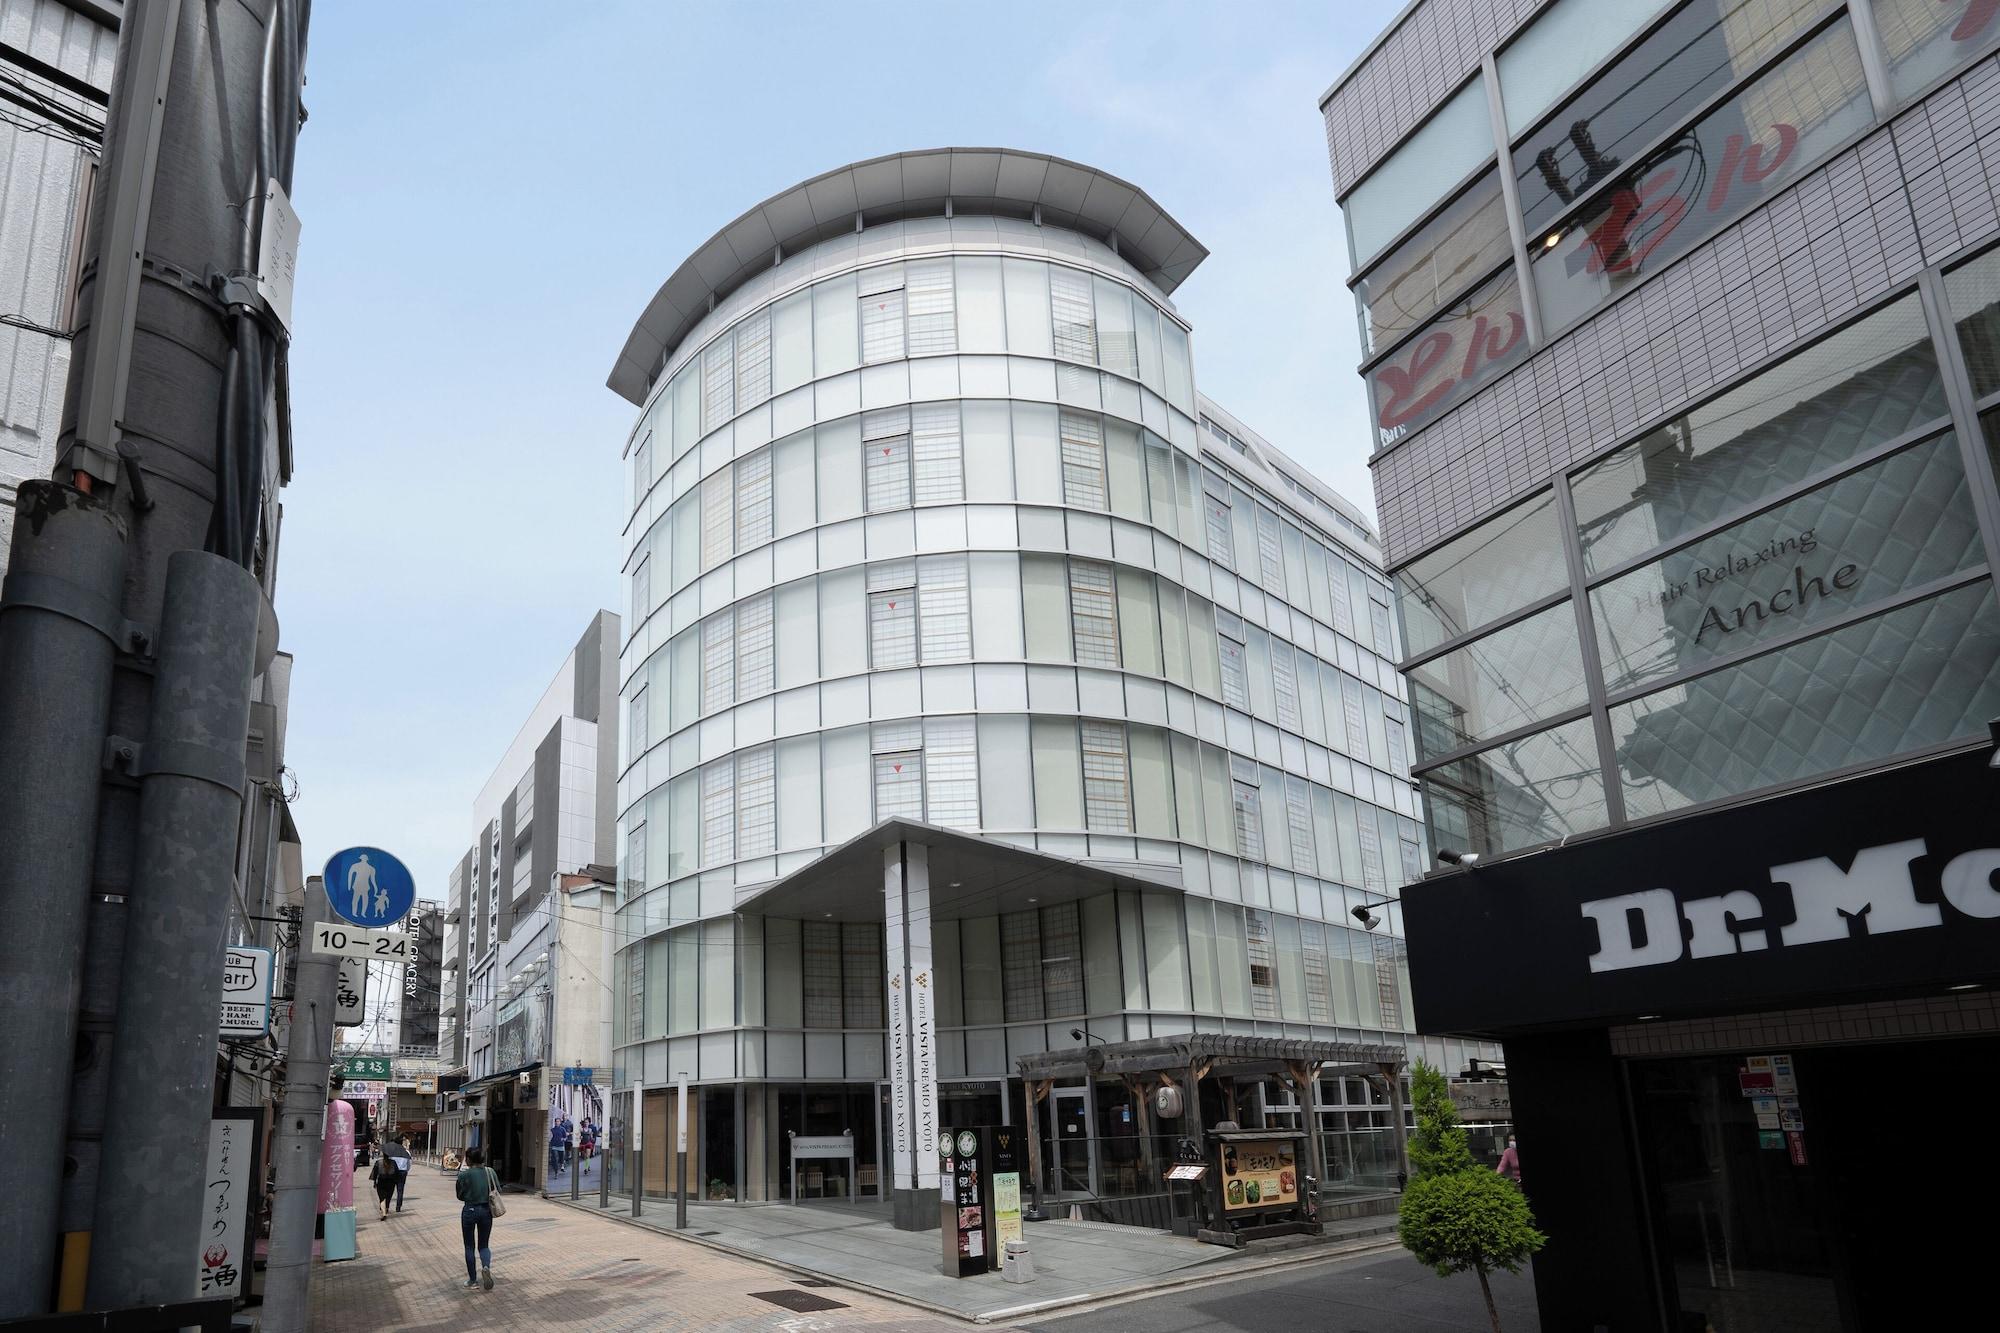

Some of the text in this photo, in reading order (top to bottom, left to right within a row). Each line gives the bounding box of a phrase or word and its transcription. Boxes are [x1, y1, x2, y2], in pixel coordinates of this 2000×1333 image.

[1634, 527, 1818, 613] Hair Relaxing
[1695, 560, 1859, 645] Anche
[224, 972, 249, 985] arr
[225, 957, 241, 965] UB
[406, 946, 419, 998] GRACERY
[896, 1060, 904, 1109] PREMIO
[918, 992, 932, 1152] HOTEL VISTA PREMIO KYOTO
[897, 1111, 906, 1153] KYOTO
